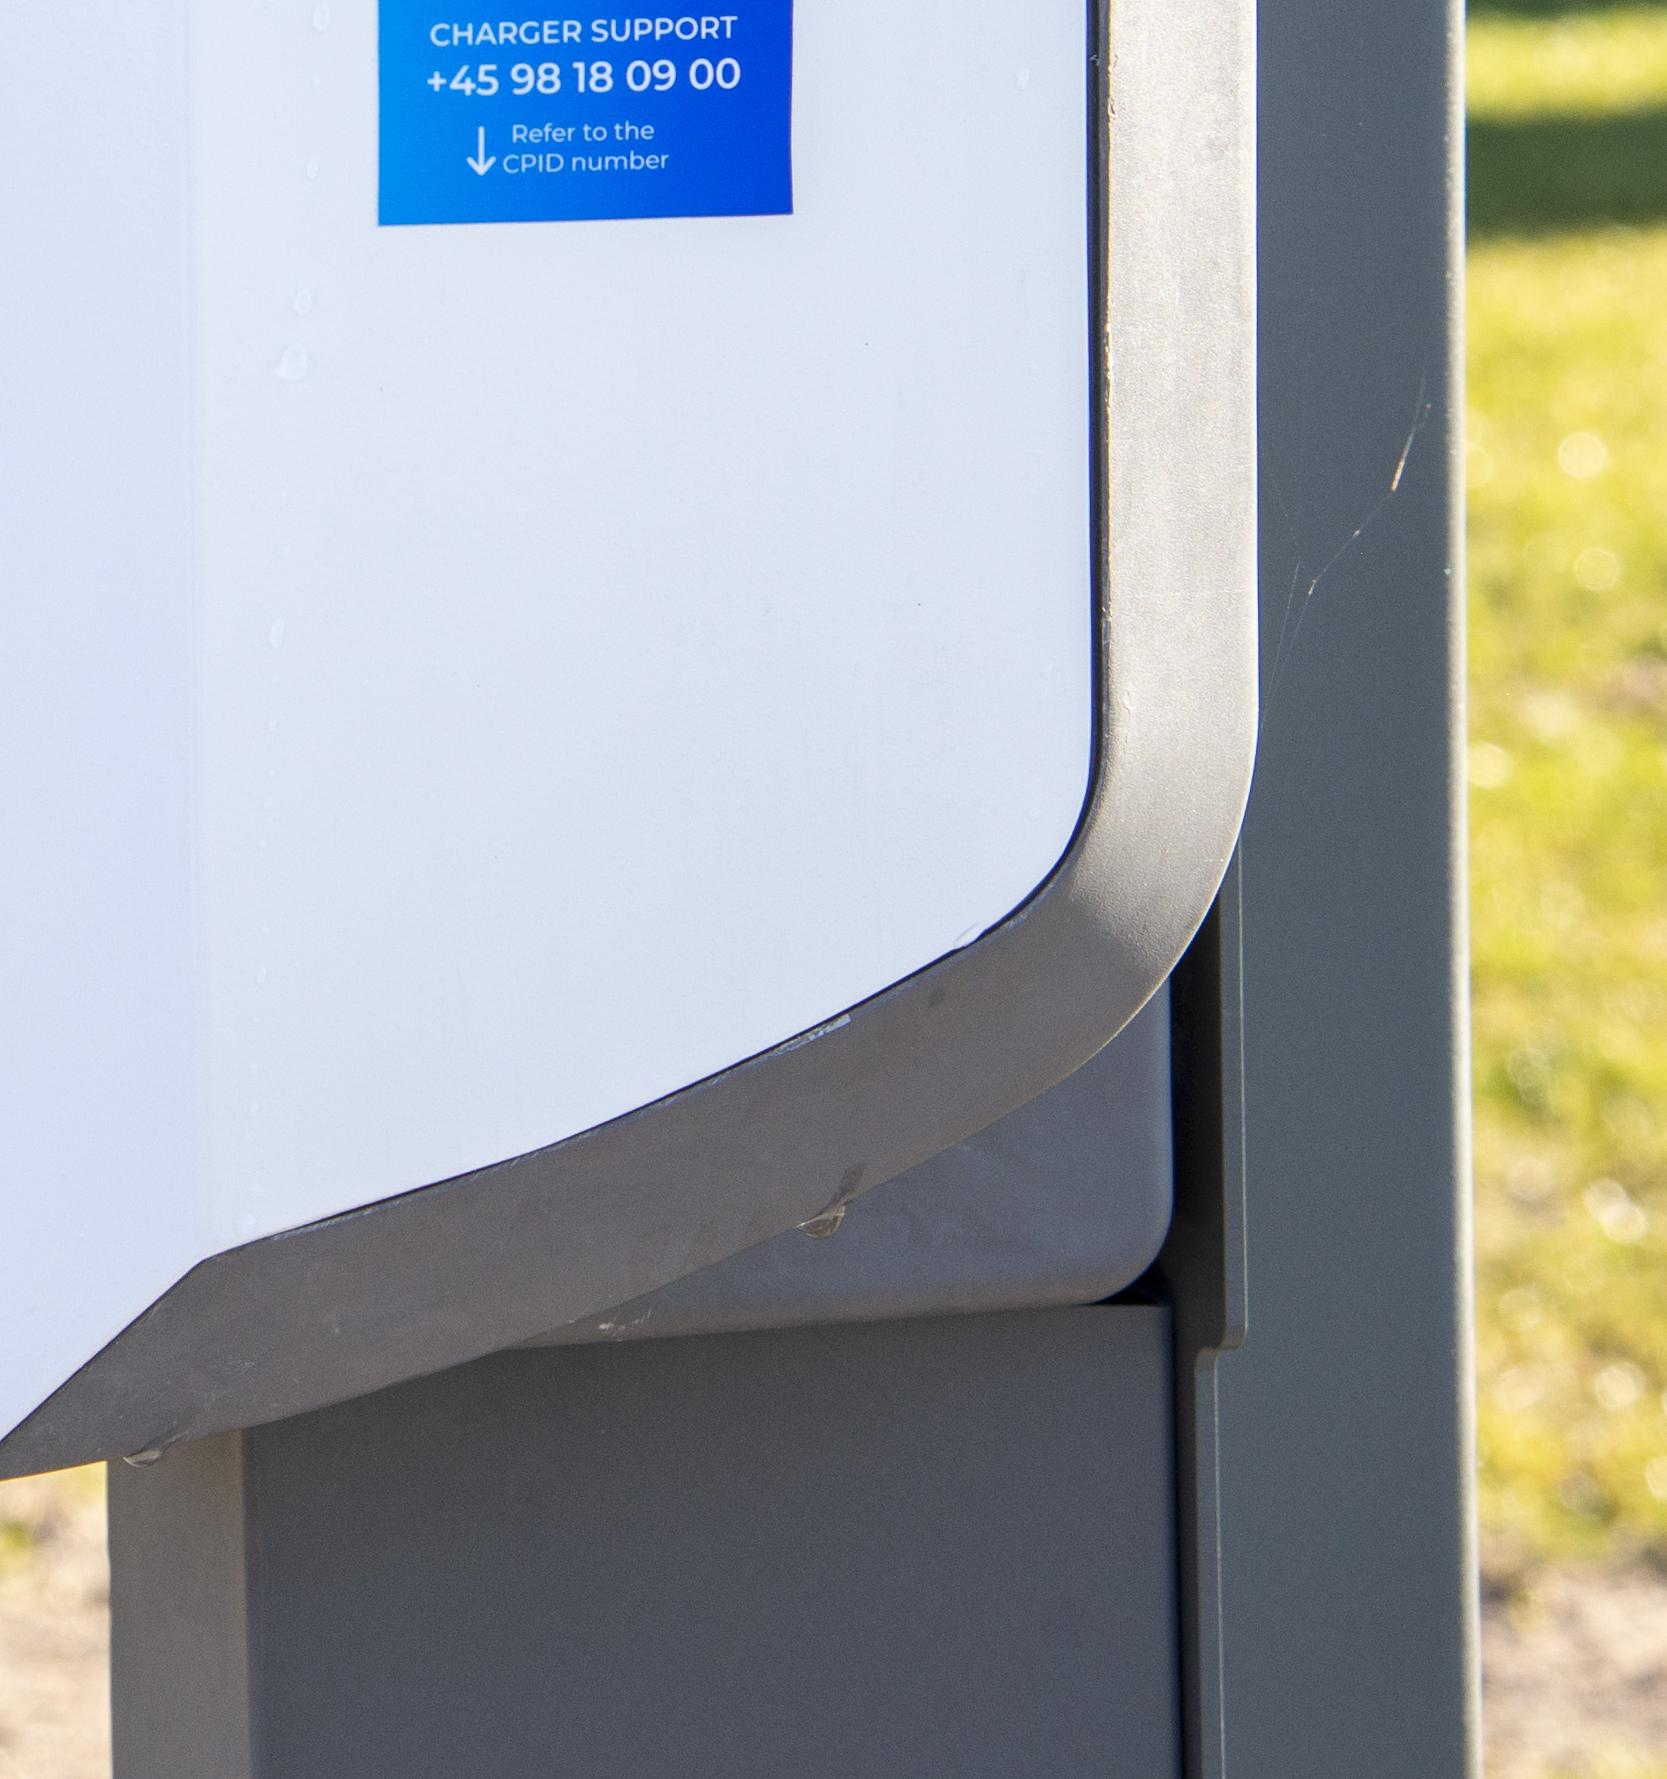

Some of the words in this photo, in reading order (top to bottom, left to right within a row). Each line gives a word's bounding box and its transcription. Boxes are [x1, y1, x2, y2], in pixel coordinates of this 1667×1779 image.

[428, 19, 583, 48] CHARGER
[590, 14, 738, 43] SUPPORT
[426, 63, 500, 97] +45
[509, 61, 562, 96] 98
[571, 59, 614, 94] 18
[625, 58, 677, 92] 09
[688, 56, 742, 91] 00
[511, 121, 576, 144] Refer
[582, 123, 609, 143] to
[613, 120, 655, 141] the
[502, 151, 565, 174] CPID
[571, 149, 670, 172] number
